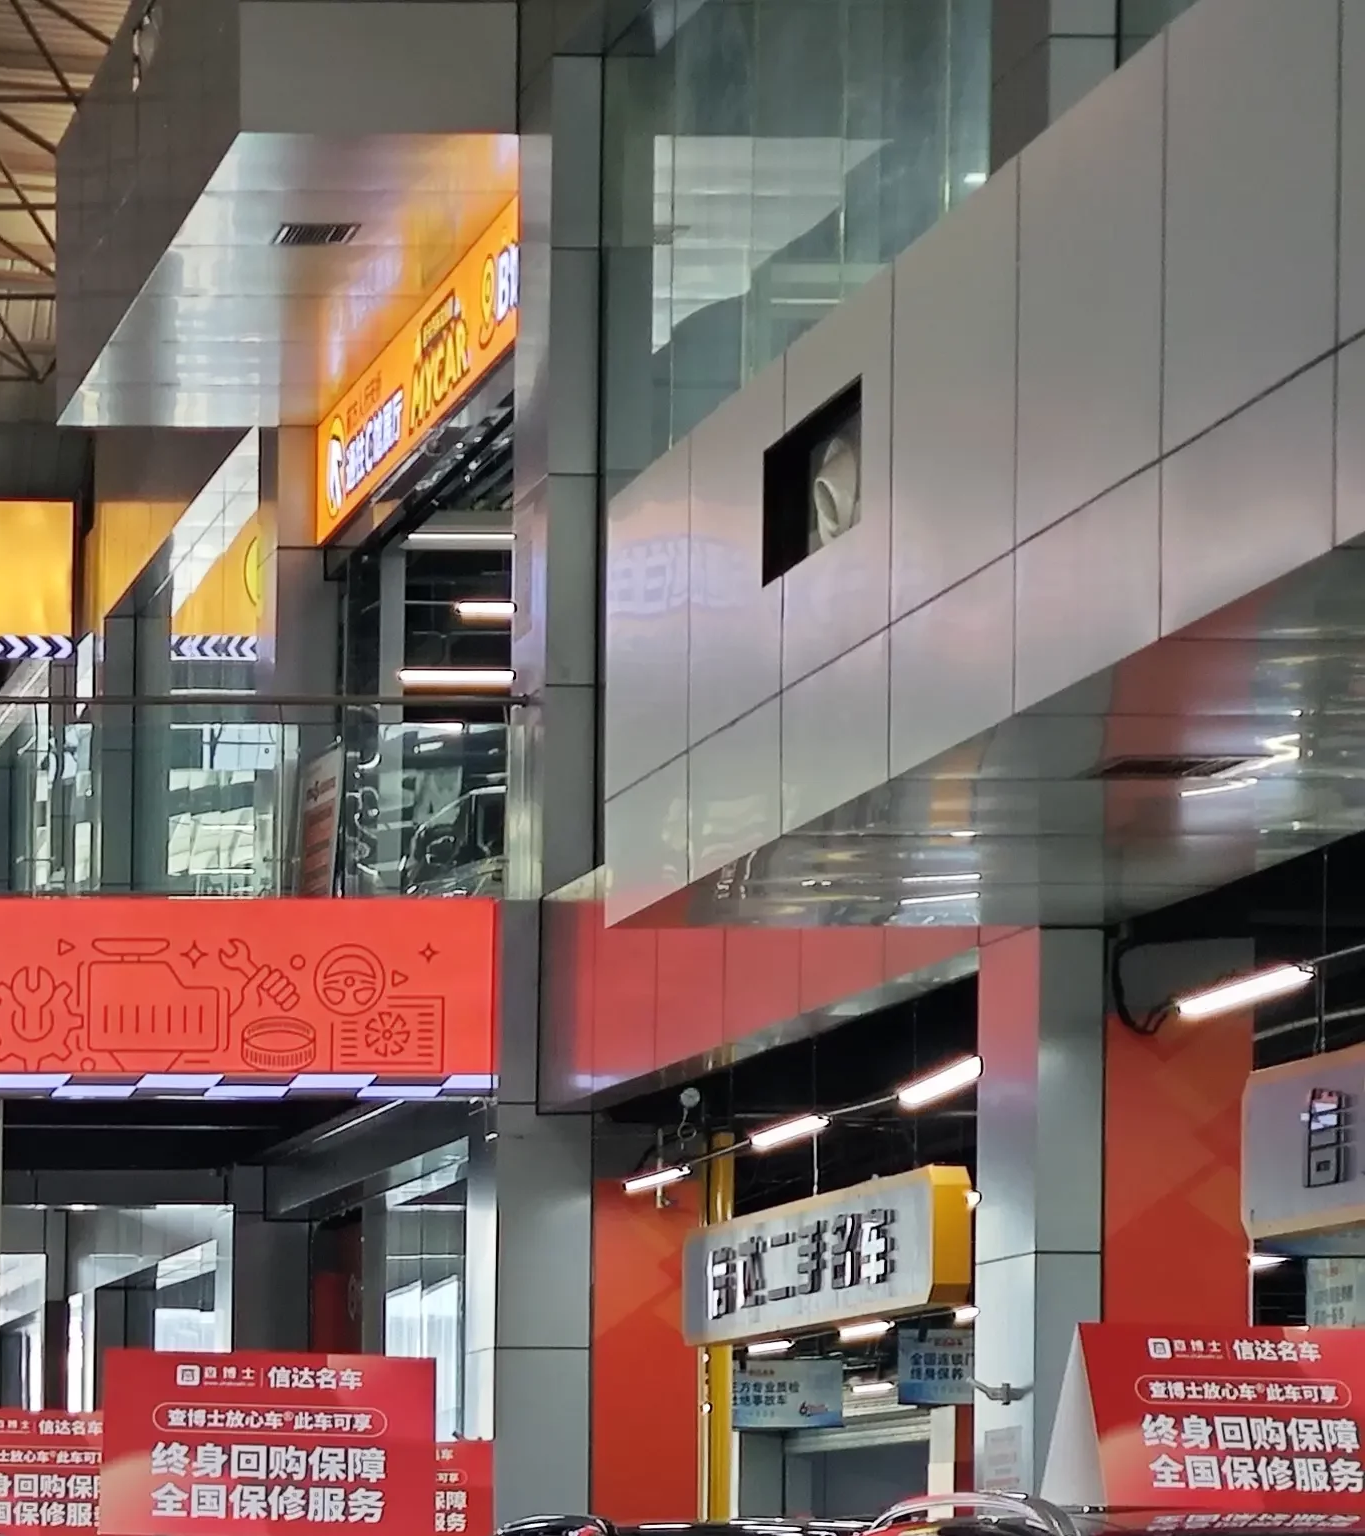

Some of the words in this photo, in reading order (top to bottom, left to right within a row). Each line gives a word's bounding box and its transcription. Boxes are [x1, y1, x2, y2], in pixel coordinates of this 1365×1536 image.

[1232, 1338, 1322, 1362] 信达名车
[267, 1365, 364, 1391] 信达名车
[1141, 1413, 1361, 1453] 终身回购保障
[151, 1441, 387, 1483] 终身回购保障
[1148, 1453, 1365, 1494] 全国保修服务
[150, 1482, 386, 1523] 全国保修服务
